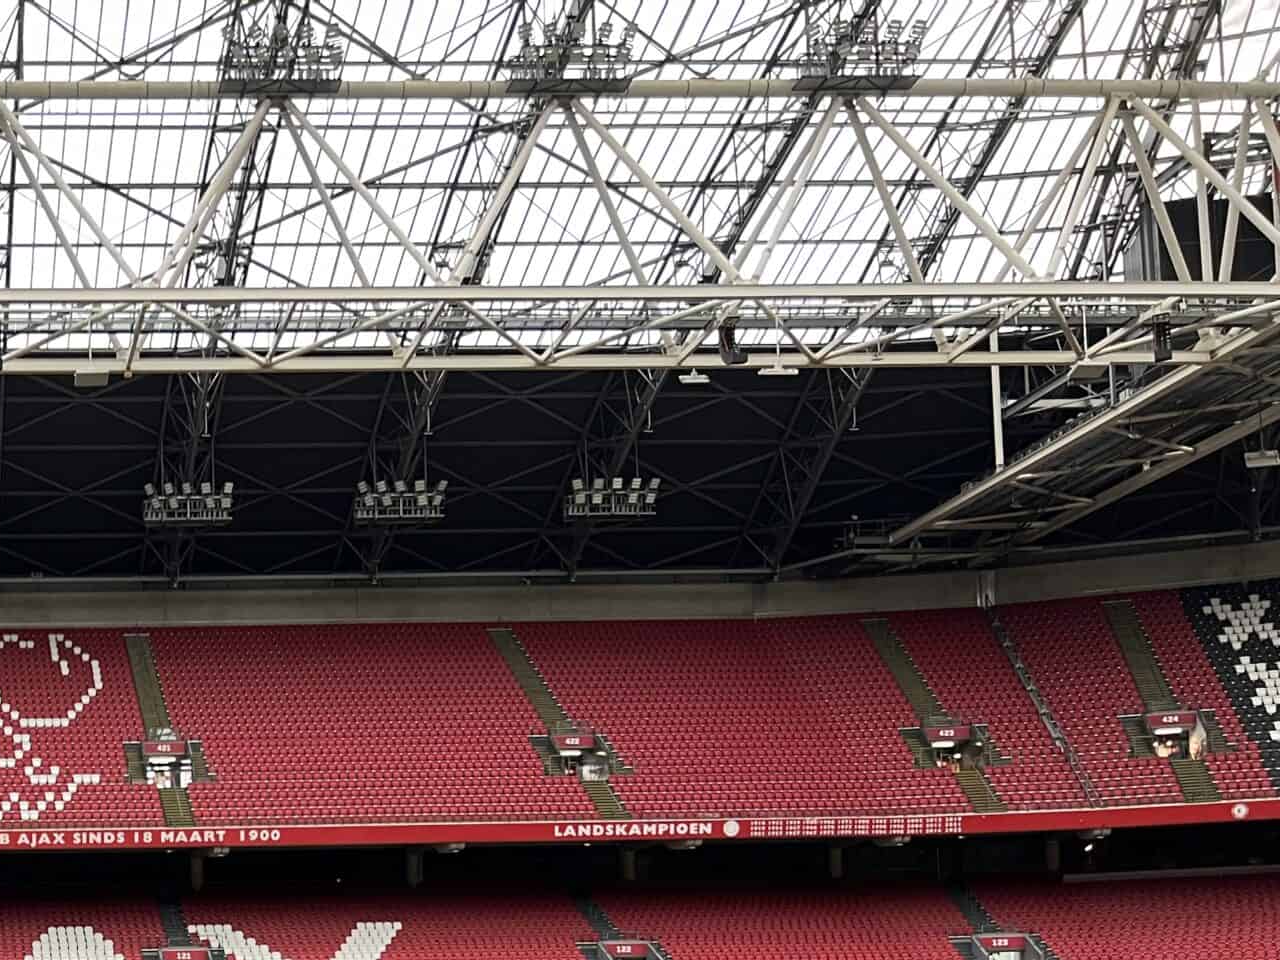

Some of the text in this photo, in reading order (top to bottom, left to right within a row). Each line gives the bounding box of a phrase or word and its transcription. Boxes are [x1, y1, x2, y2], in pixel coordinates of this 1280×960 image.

[554, 822, 713, 837] LANDSKAMPIOEN
[17, 833, 65, 848] AJAX
[72, 831, 125, 844] SINDS
[134, 832, 152, 843] 18
[160, 830, 226, 843] MAART
[239, 829, 281, 842] 1900
